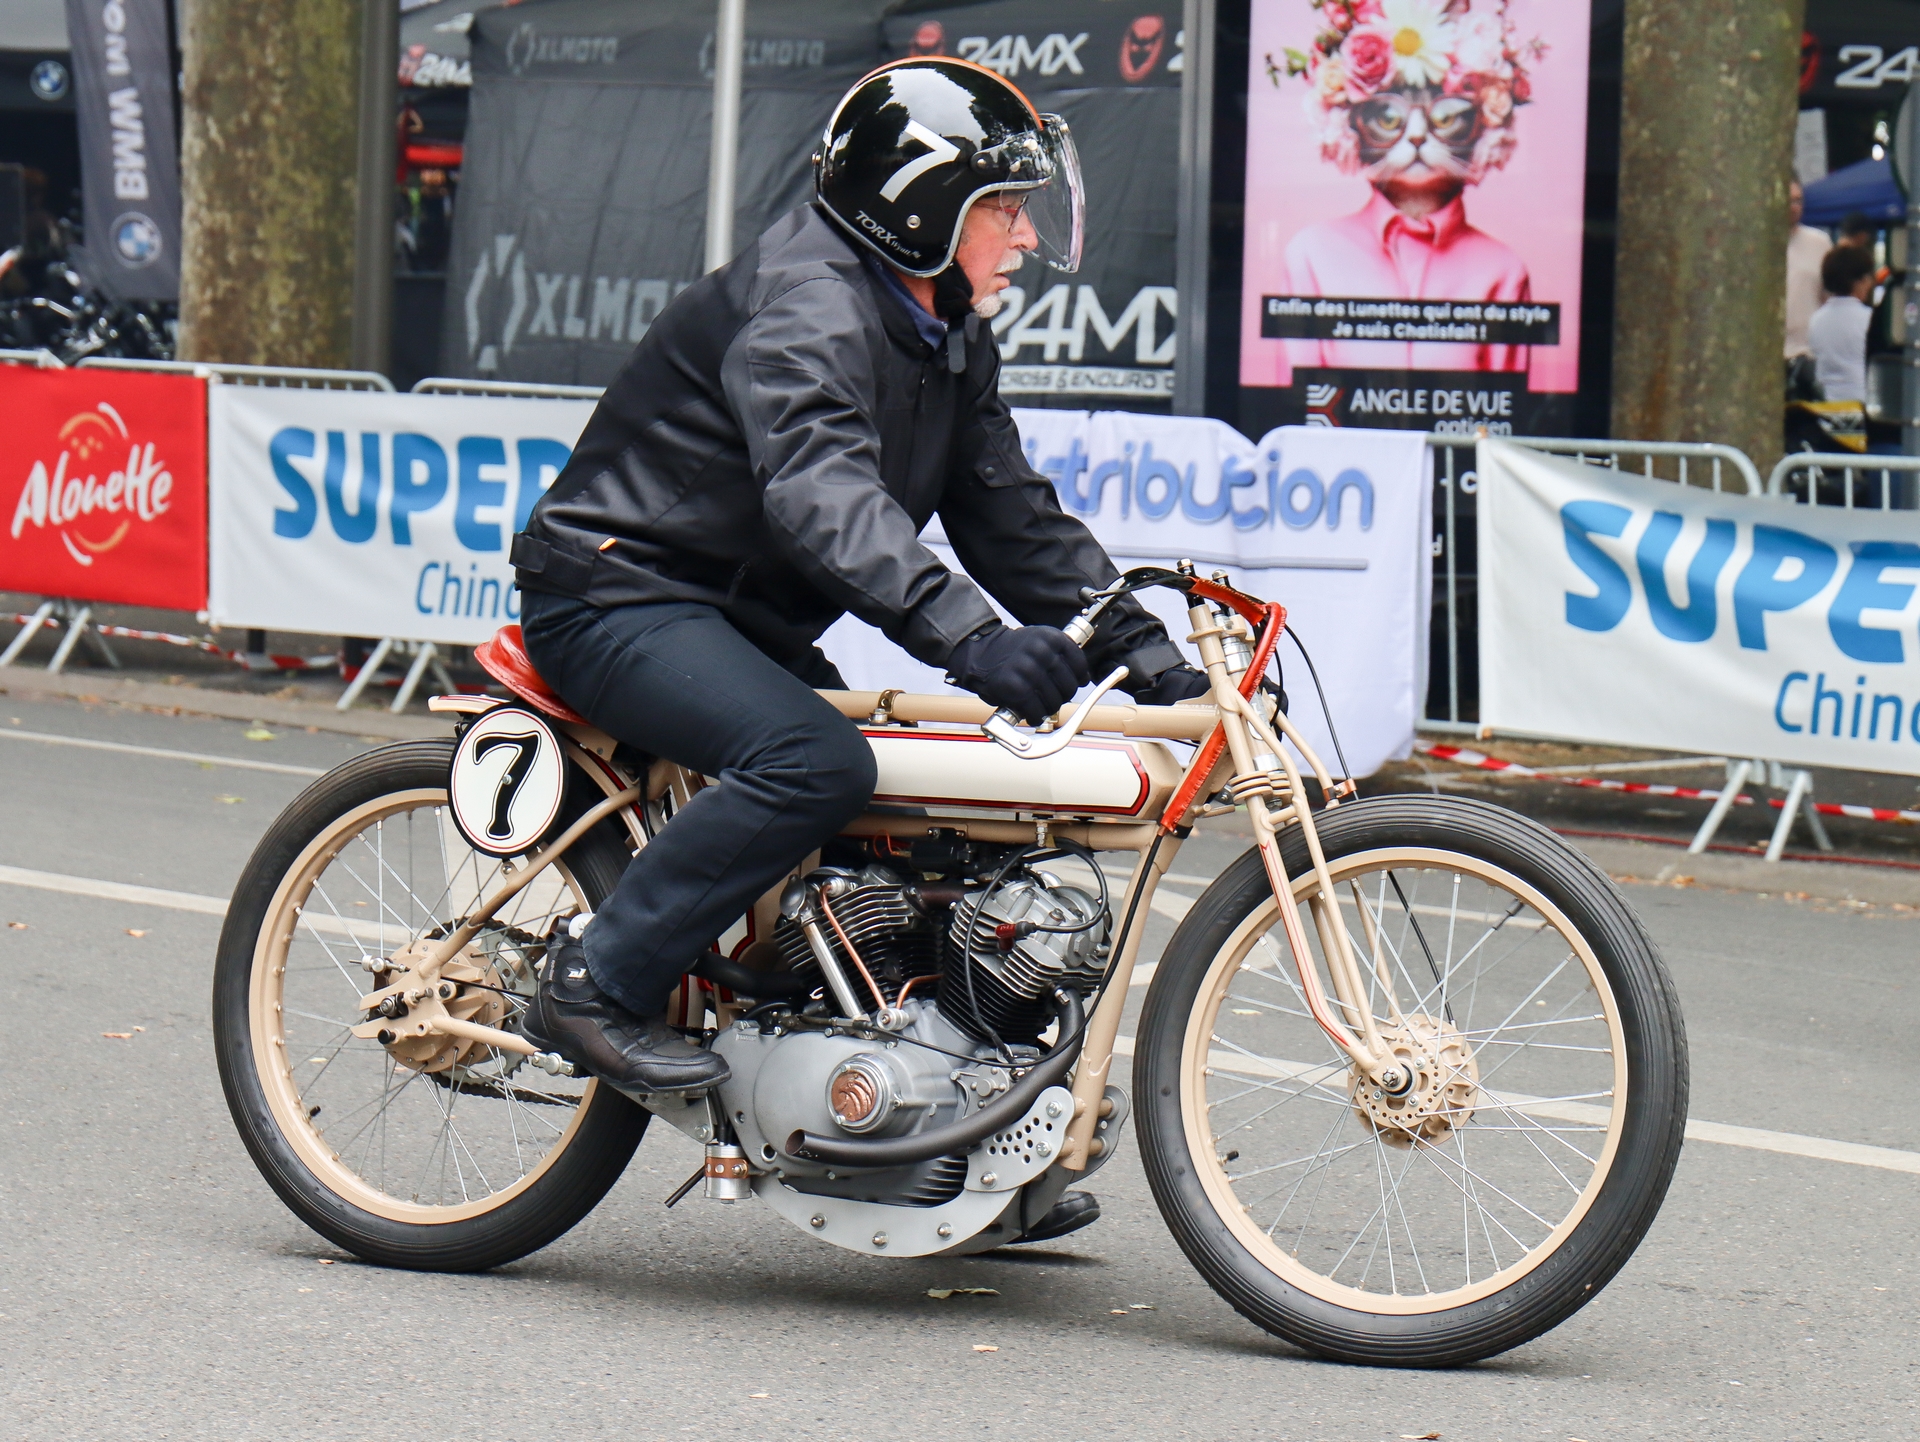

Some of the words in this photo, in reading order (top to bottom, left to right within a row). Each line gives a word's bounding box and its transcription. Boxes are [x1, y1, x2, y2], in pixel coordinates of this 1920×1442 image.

[103, 0, 131, 76] MO
[537, 36, 618, 64] XLMOTO
[742, 39, 824, 65] LMOTO
[957, 33, 1089, 77] 24MX
[108, 87, 149, 200] BMW
[879, 119, 961, 203] 7
[855, 210, 898, 244] TORX
[528, 272, 694, 343] XLMO
[1268, 298, 1312, 316] Enfin
[1314, 300, 1346, 317] des
[1348, 301, 1420, 319] Lunettes
[1423, 302, 1451, 323] qui
[1453, 304, 1482, 320] ont
[1484, 304, 1507, 322] du
[1509, 305, 1551, 327] style
[1332, 320, 1354, 338] Je
[1356, 320, 1391, 339] suis
[1480, 323, 1487, 341] !
[1072, 371, 1157, 390] ENDURO
[1350, 387, 1428, 415] ANGLE
[1432, 389, 1463, 416] DE
[1466, 390, 1512, 416] VUE
[11, 442, 173, 540] Alouette
[1559, 499, 1920, 664] SUPE
[473, 730, 542, 840] 7
